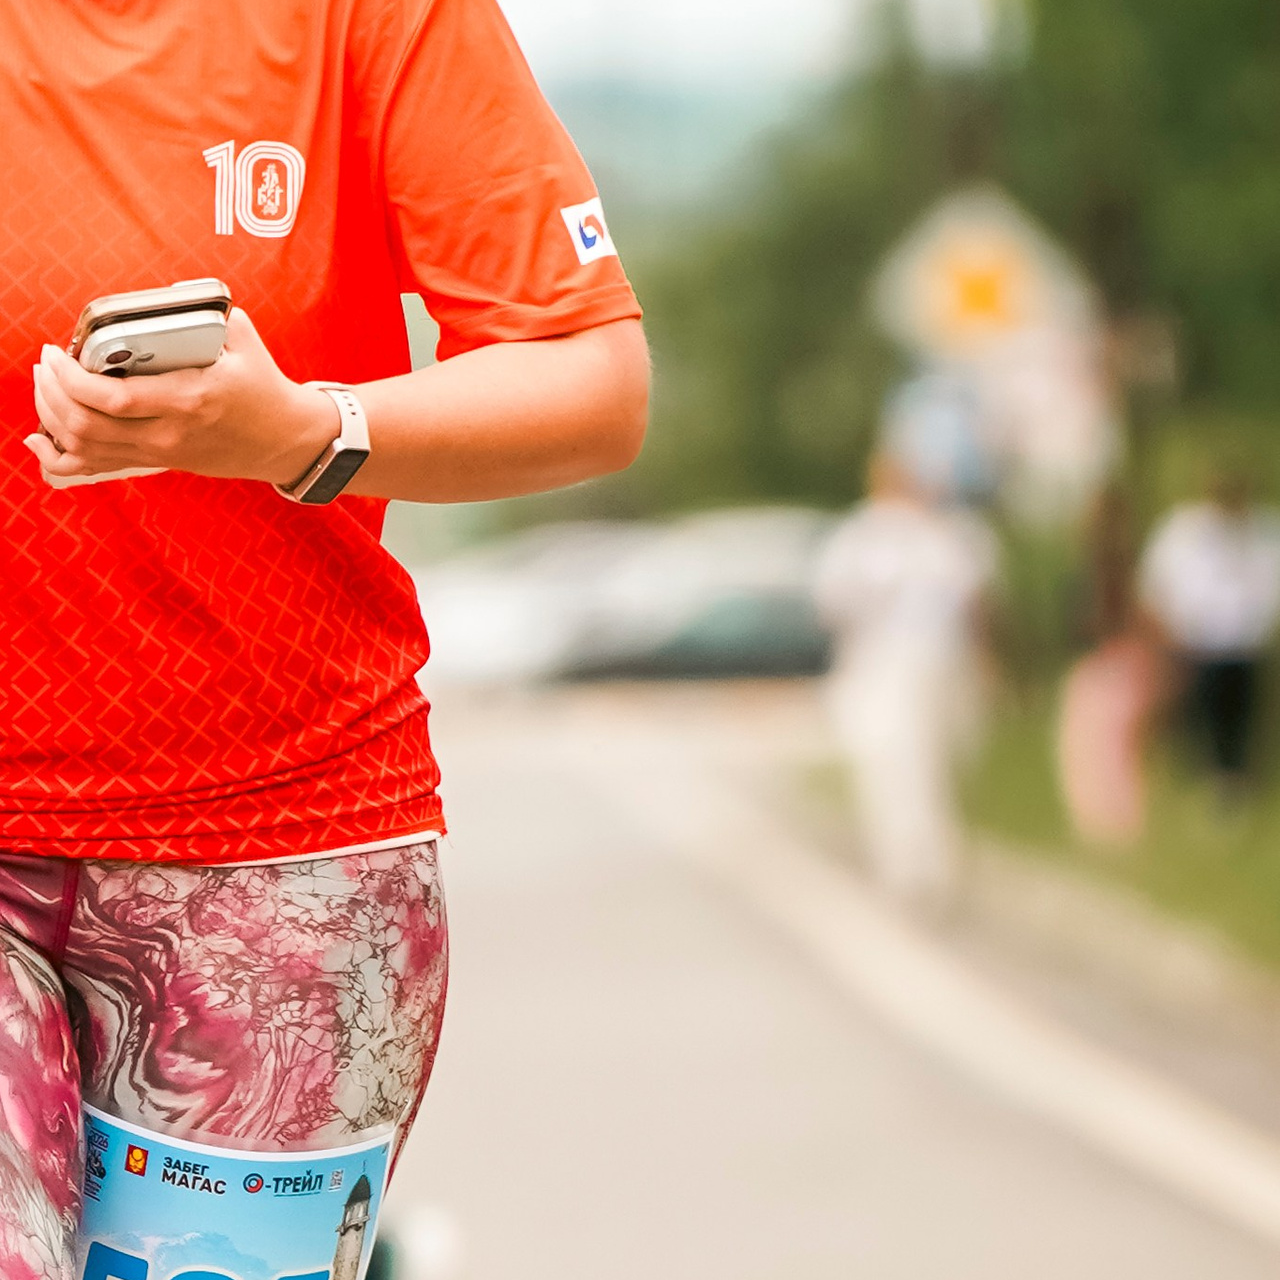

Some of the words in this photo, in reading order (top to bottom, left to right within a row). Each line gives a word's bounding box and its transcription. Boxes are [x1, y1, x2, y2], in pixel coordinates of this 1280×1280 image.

[202, 139, 306, 238] 10
[163, 1156, 210, 1176] ЗАБЕГ
[161, 1168, 227, 1195] МАГАС
